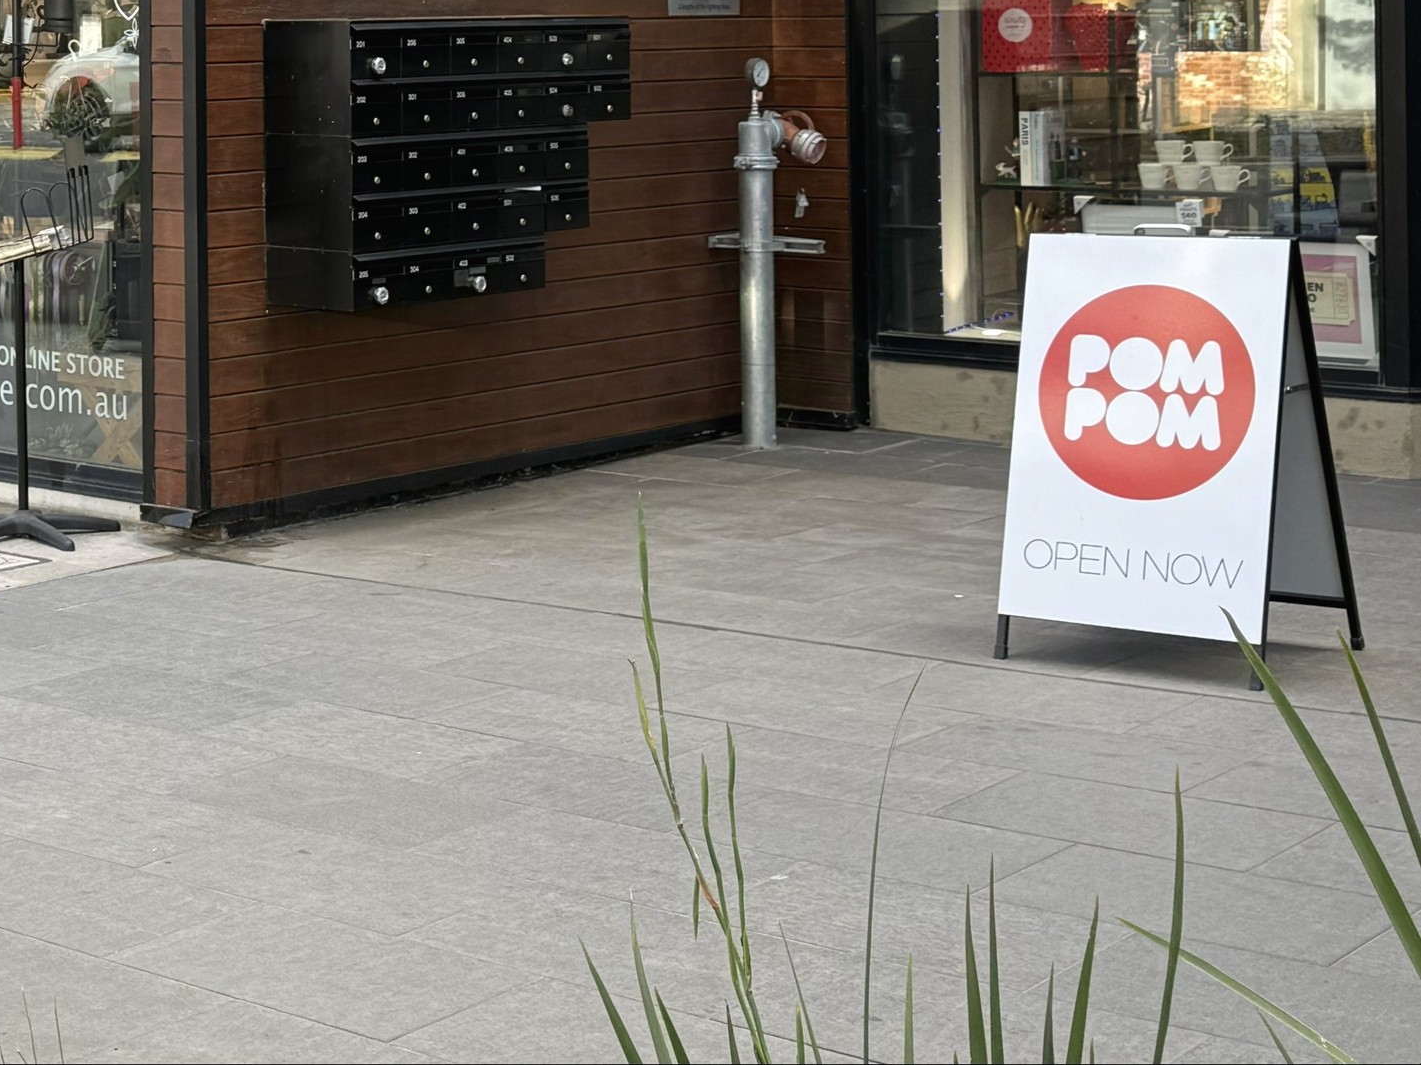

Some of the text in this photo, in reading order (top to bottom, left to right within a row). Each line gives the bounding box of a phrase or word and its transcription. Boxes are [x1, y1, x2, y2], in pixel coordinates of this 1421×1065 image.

[1020, 118, 1029, 146] PARIS
[67, 354, 126, 380] STORE
[1068, 334, 1224, 396] POM
[1064, 387, 1221, 451] POM
[1023, 538, 1244, 589] OPEN NOW
